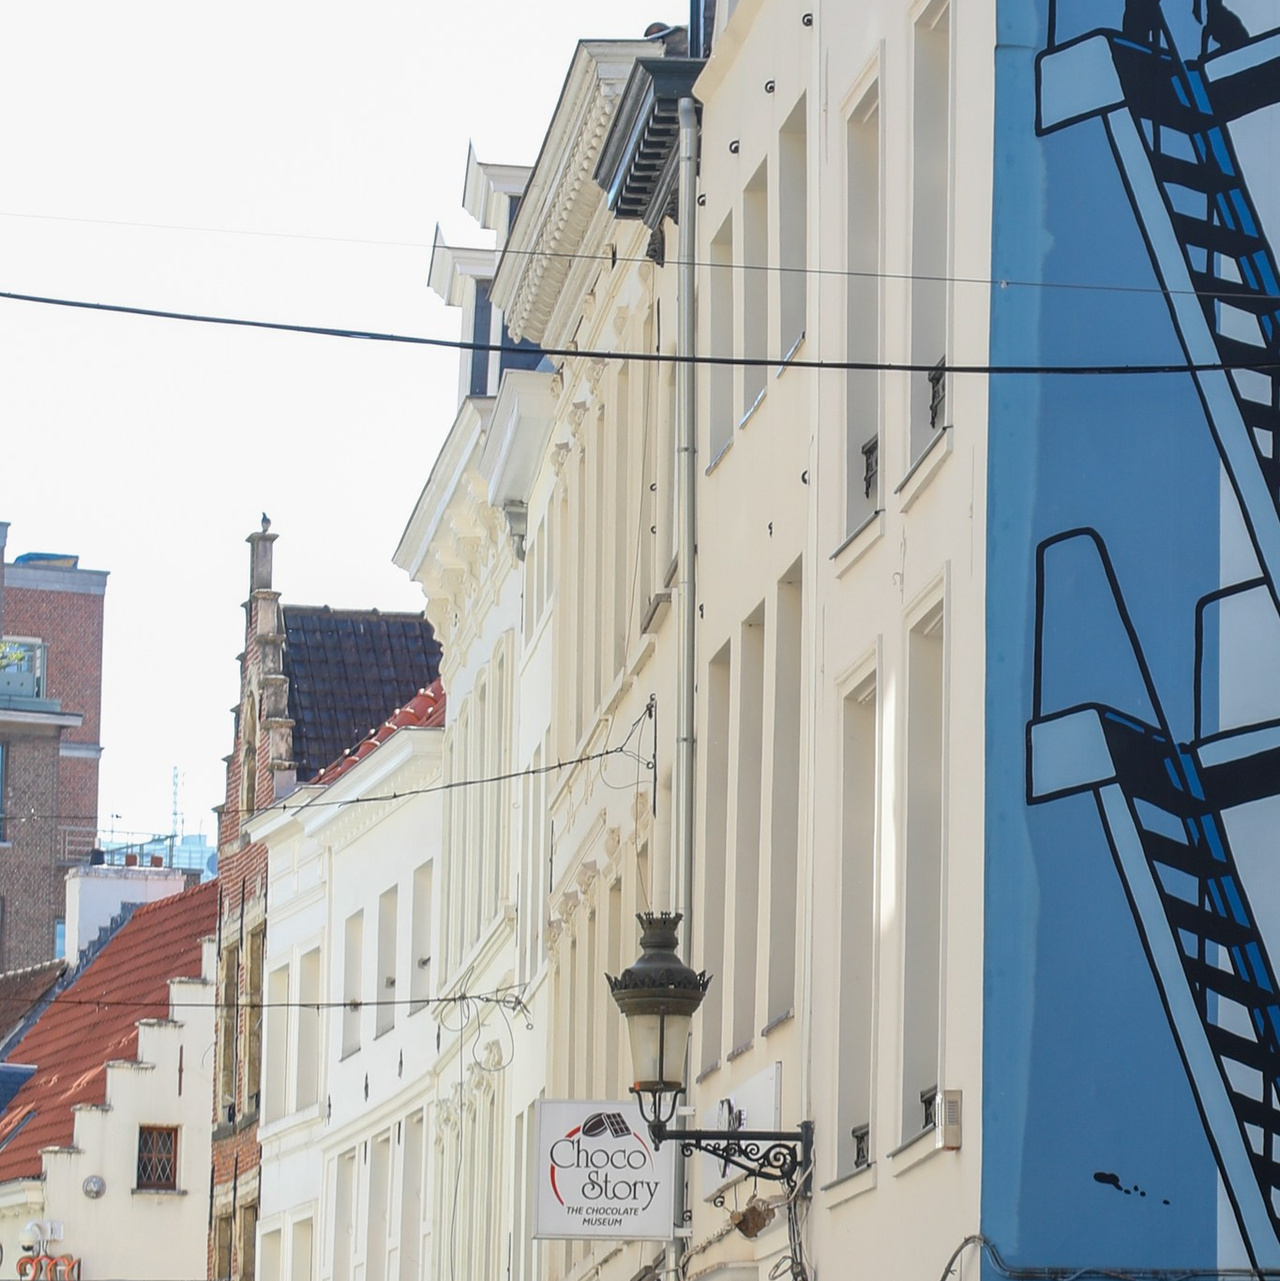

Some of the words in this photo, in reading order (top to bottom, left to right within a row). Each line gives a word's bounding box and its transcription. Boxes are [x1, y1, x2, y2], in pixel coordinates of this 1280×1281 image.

[549, 1136, 647, 1170] Choco
[581, 1169, 660, 1212] Story
[566, 1206, 583, 1216] THE
[585, 1206, 639, 1217] CHOCOLATE
[582, 1218, 623, 1227] MUSEUM
